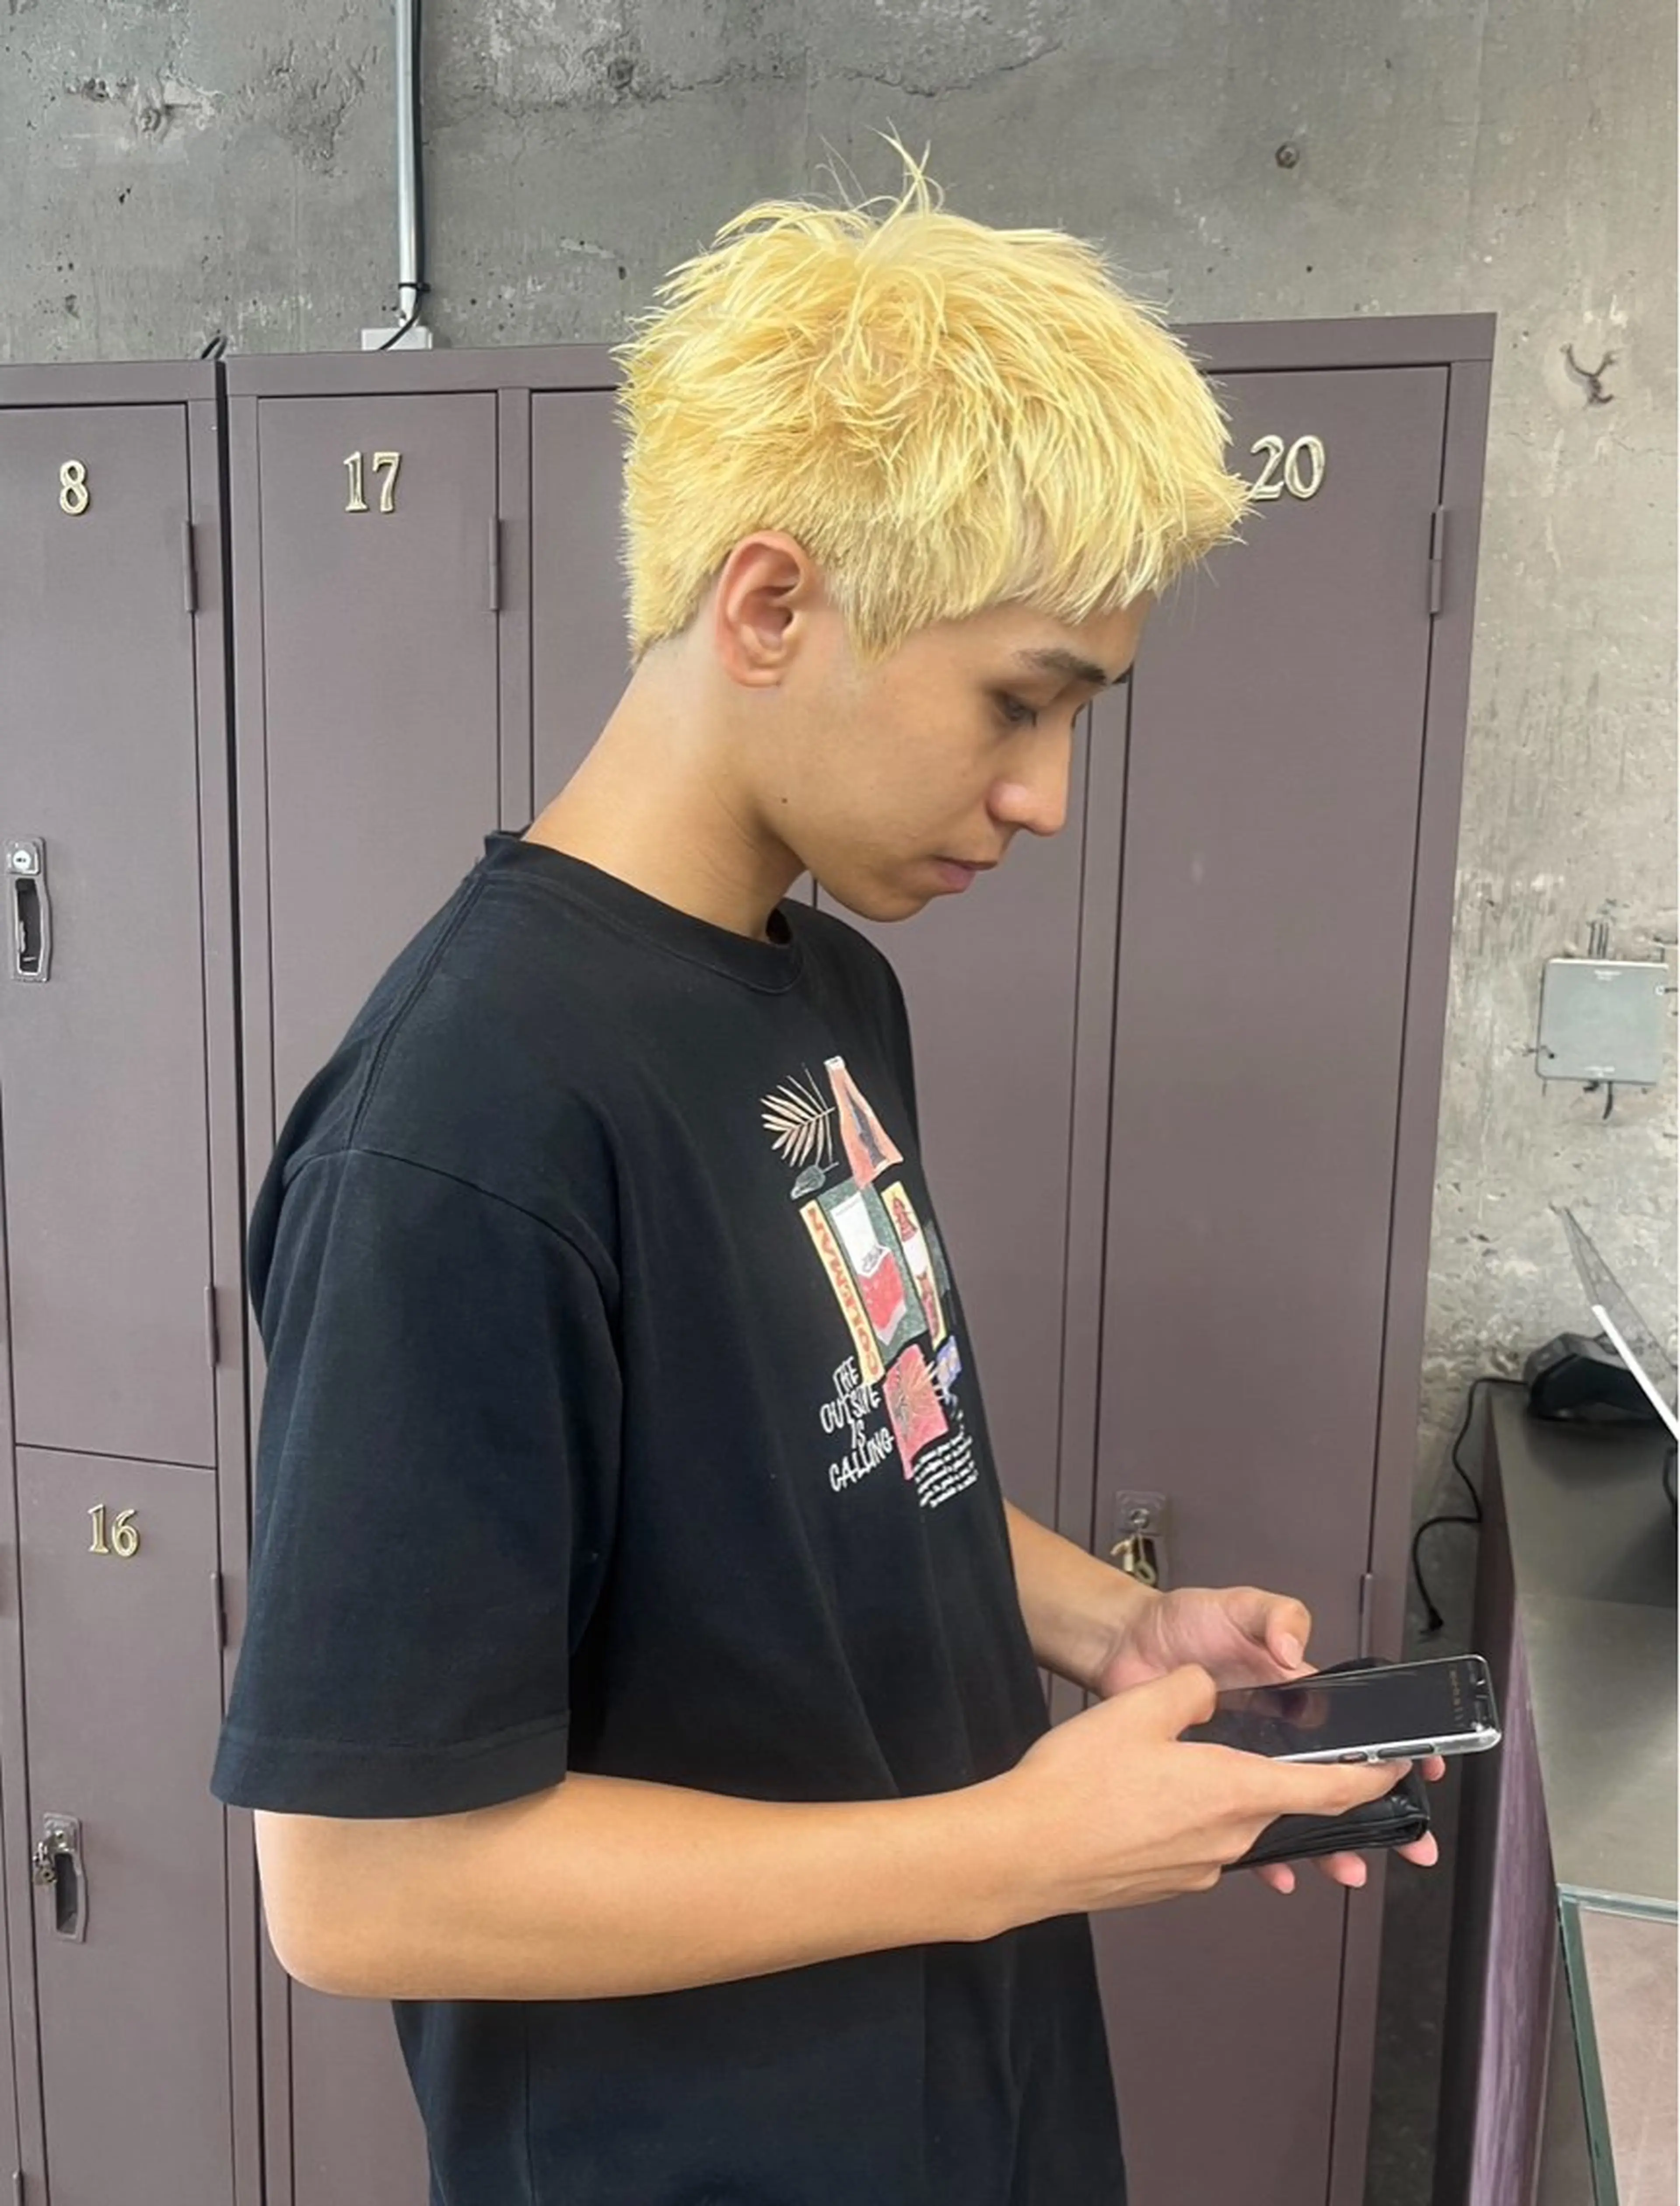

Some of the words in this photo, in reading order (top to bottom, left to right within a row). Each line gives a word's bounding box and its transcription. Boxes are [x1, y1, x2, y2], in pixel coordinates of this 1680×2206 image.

[60, 460, 89, 515] 8
[343, 451, 401, 513] 17
[1250, 434, 1325, 500] 20
[833, 1355, 860, 1399] THE
[829, 1427, 894, 1492] CALLING
[851, 1419, 866, 1449] IS
[88, 1503, 140, 1557] 16
